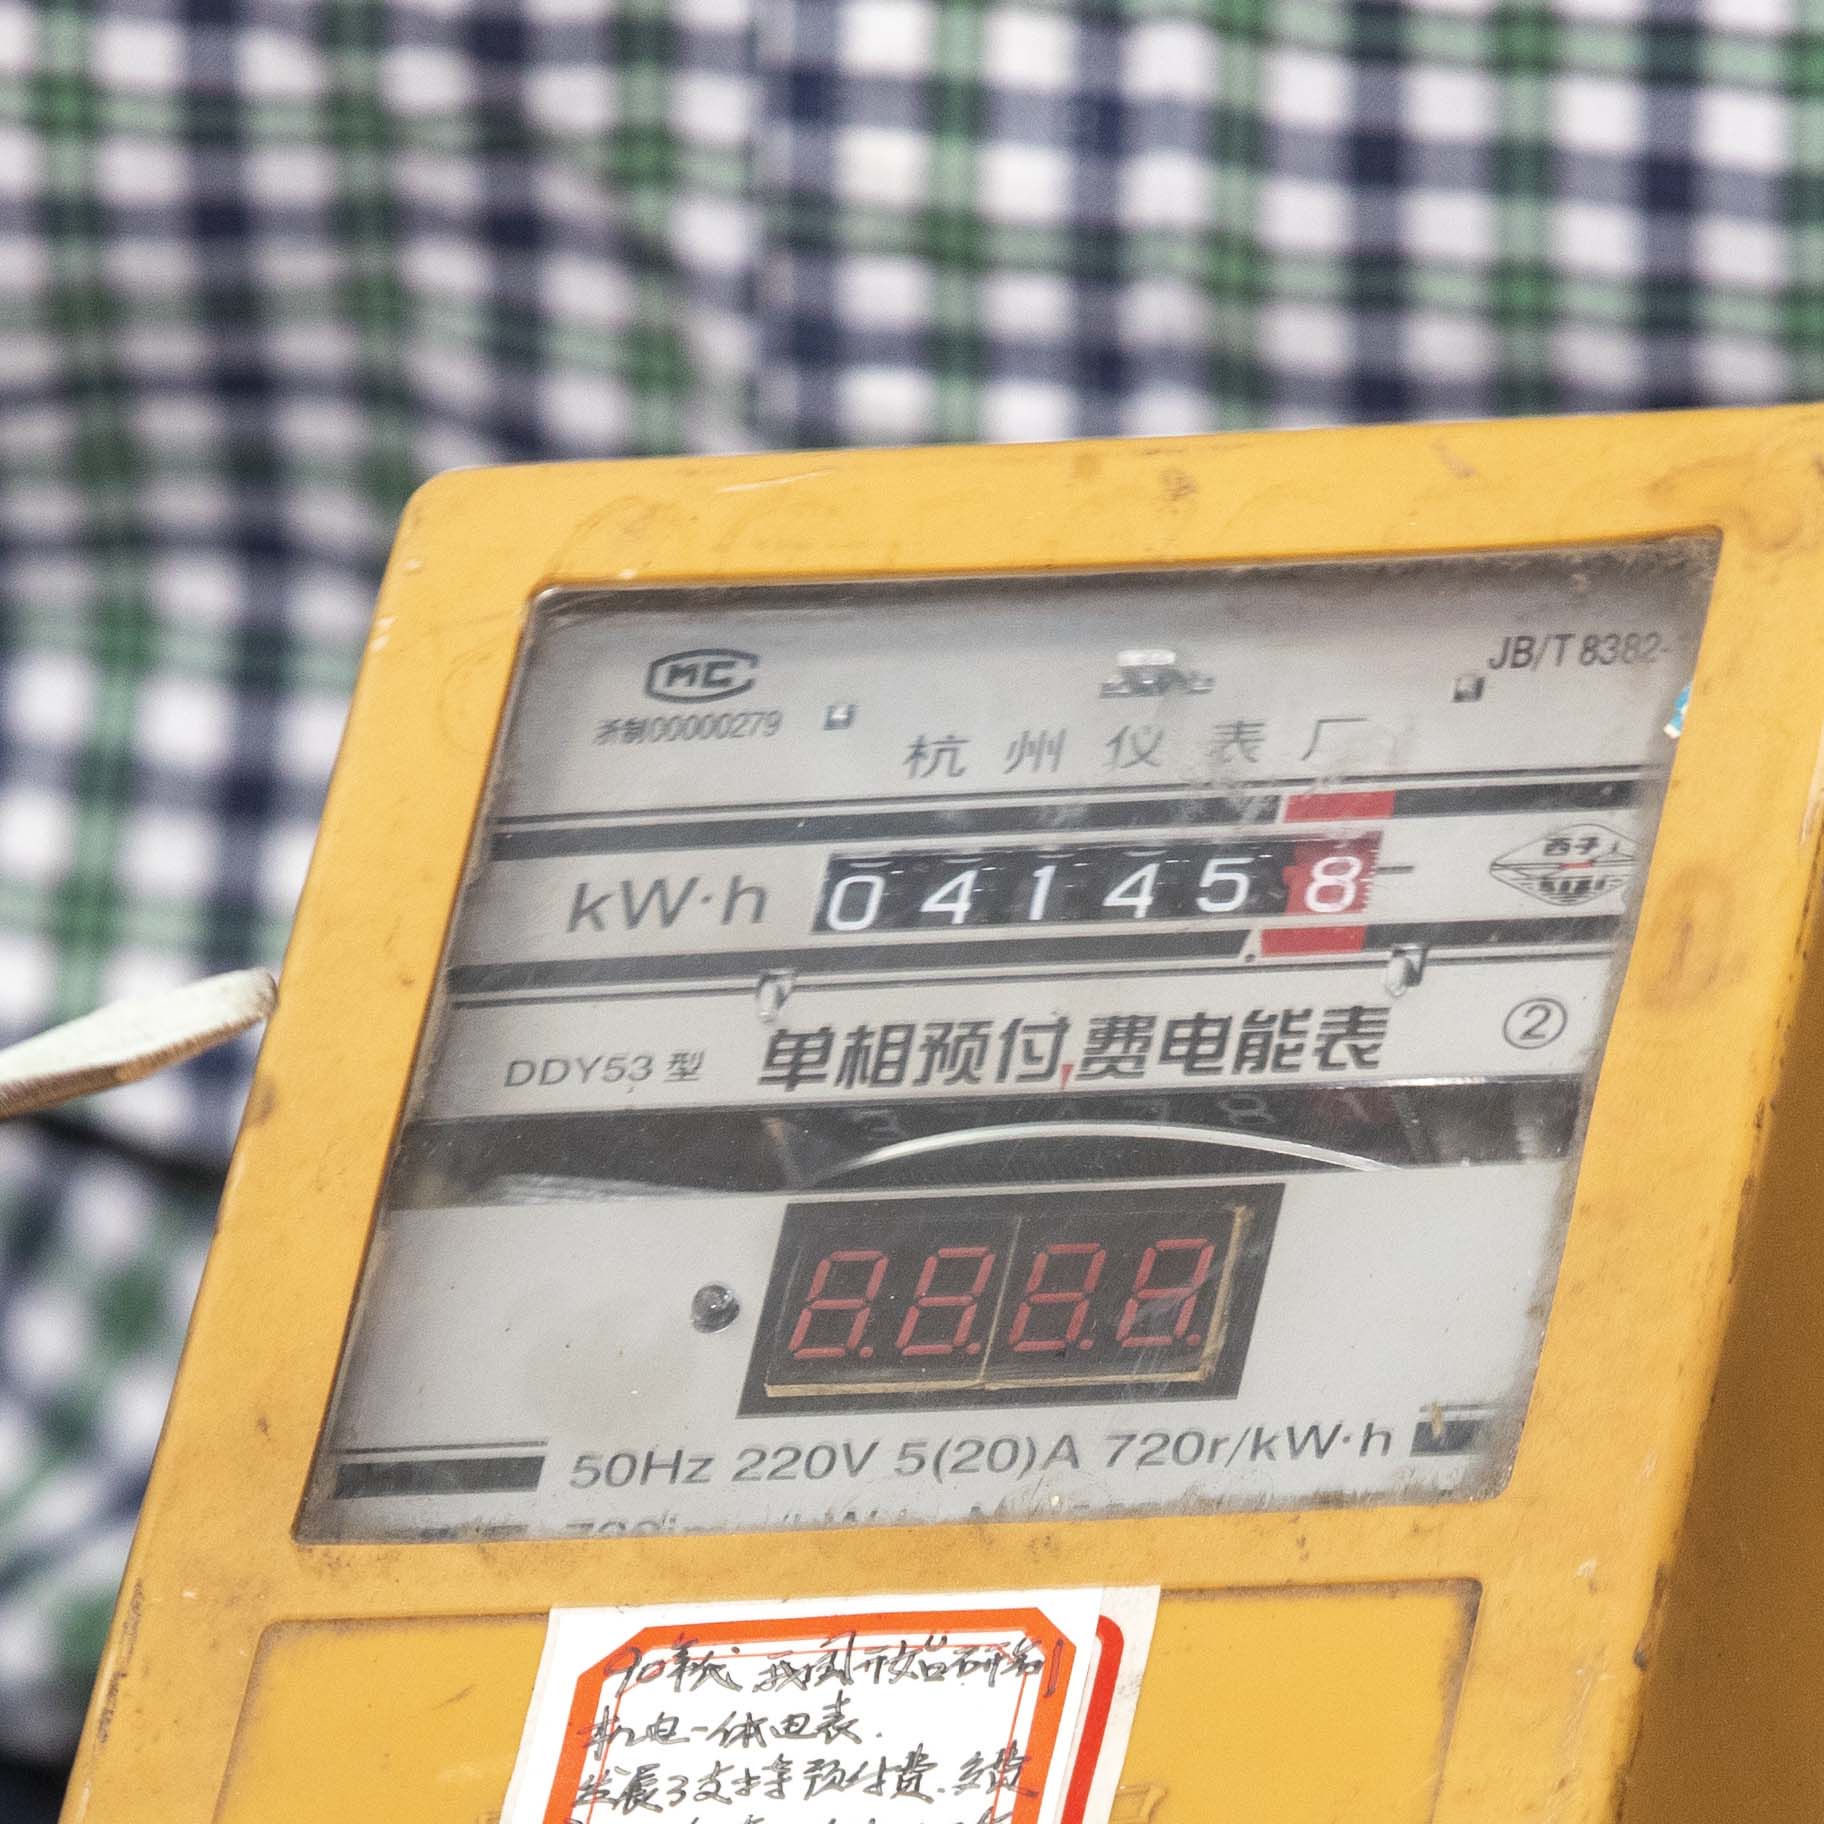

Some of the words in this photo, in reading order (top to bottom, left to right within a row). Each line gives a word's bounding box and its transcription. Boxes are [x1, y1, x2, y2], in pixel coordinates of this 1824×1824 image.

[1487, 632, 1577, 671] JB/T
[902, 717, 1368, 780] 杭州仪表厂
[827, 855, 1363, 931] 041458
[503, 1054, 654, 1088] DDY53
[666, 1049, 705, 1078] 型
[762, 1005, 1392, 1091] 单相预付费电能表
[568, 1449, 716, 1489] 50Hz
[731, 1441, 882, 1483] 220V
[893, 1431, 1081, 1486] 5(20)A
